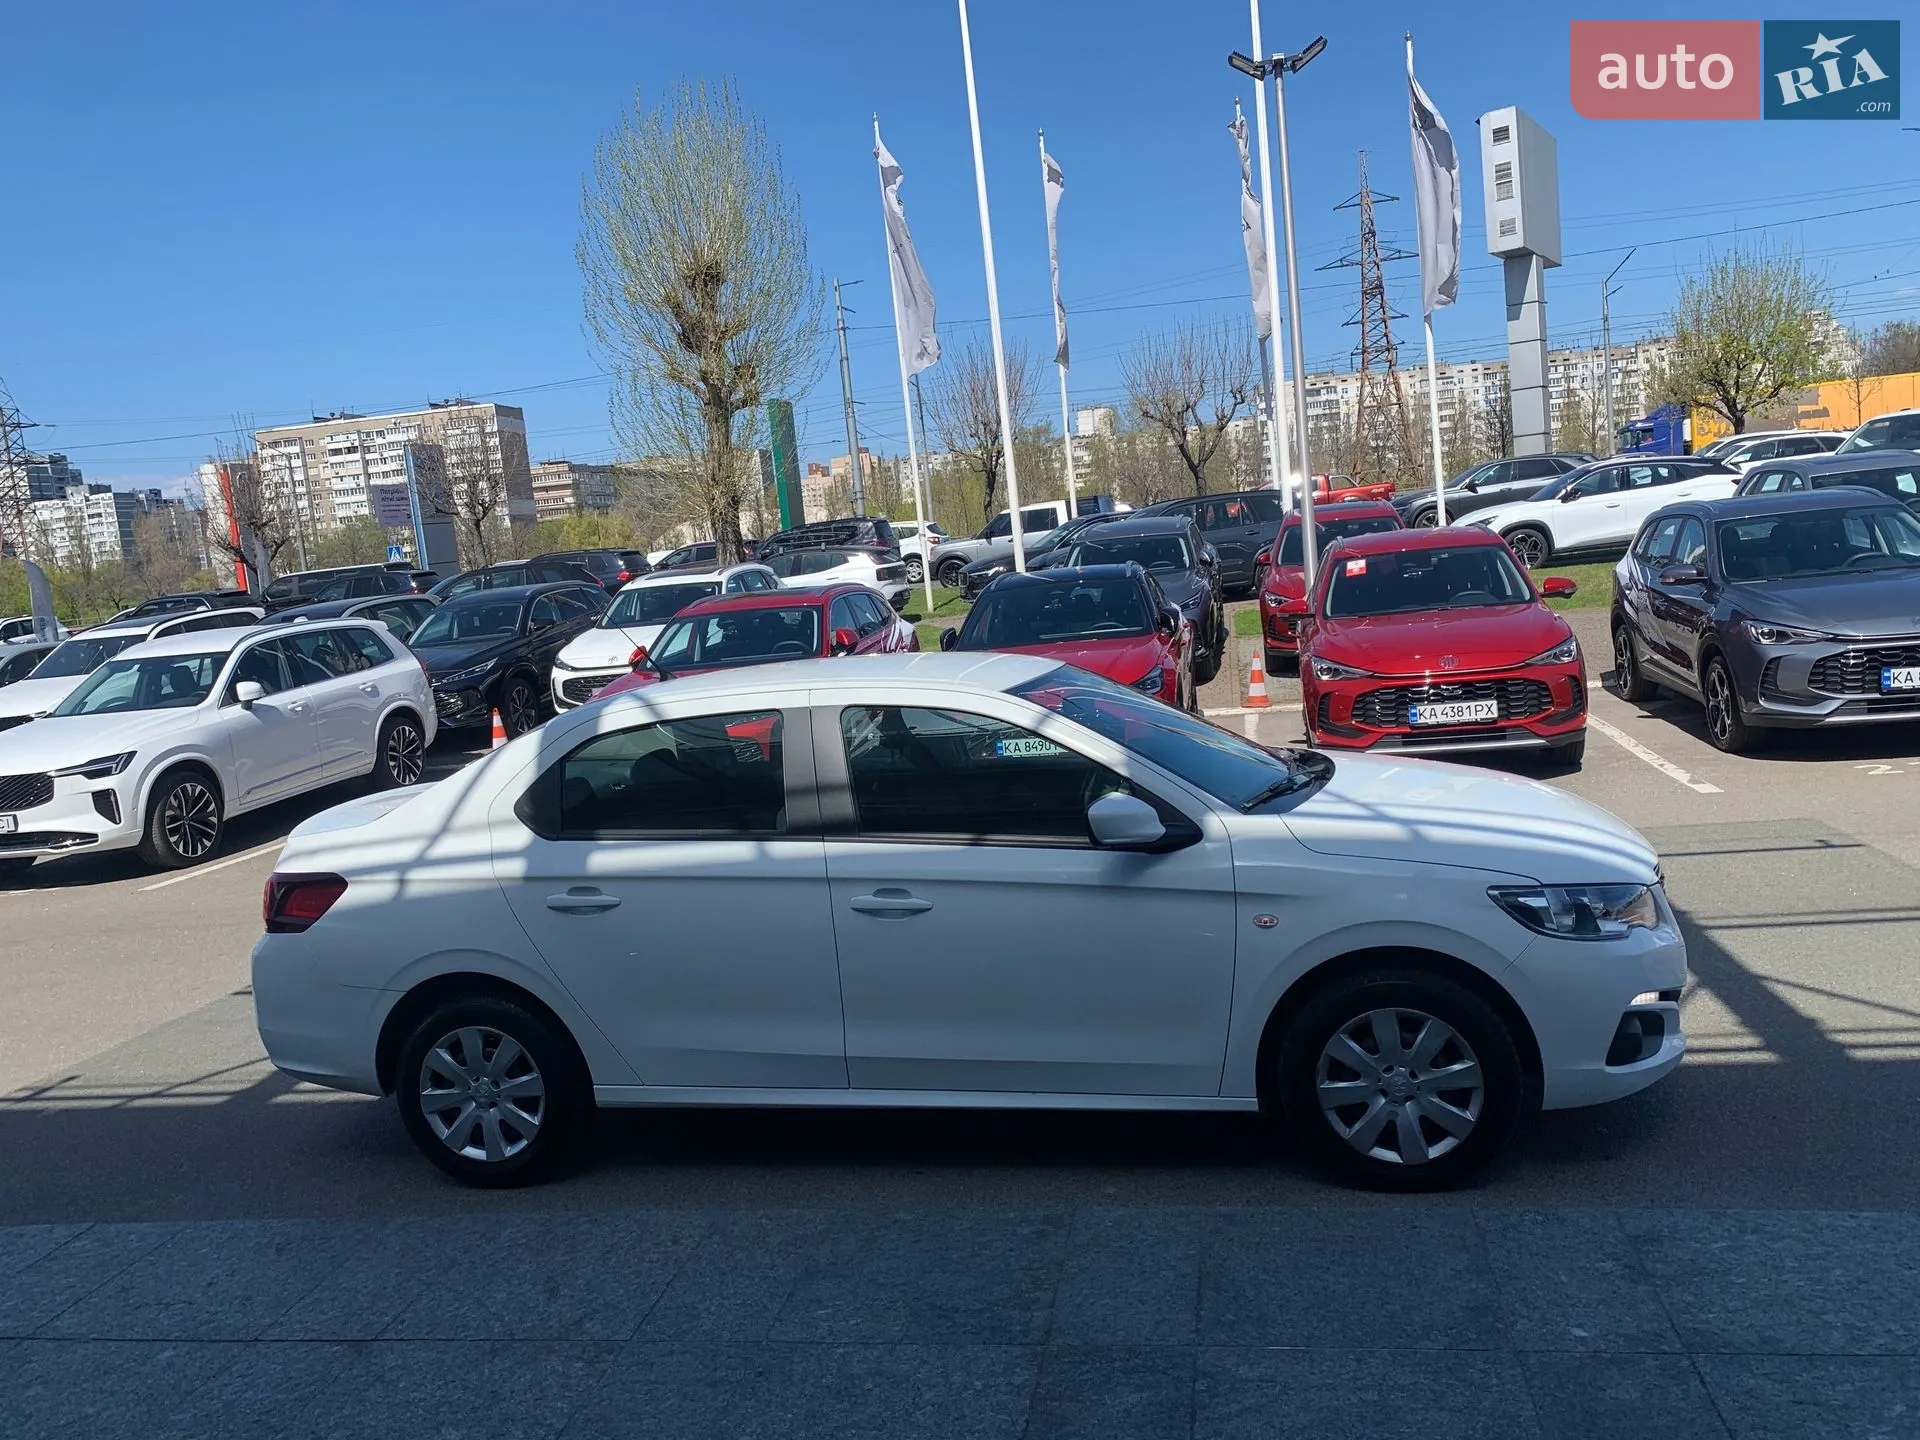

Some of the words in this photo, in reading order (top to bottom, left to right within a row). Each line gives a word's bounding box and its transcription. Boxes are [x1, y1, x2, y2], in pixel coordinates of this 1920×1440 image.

[1892, 670, 1914, 684] KA
[1418, 707, 1438, 720] KA
[1440, 705, 1472, 718] 4381
[1474, 703, 1494, 716] PX
[1004, 742, 1021, 753] KA
